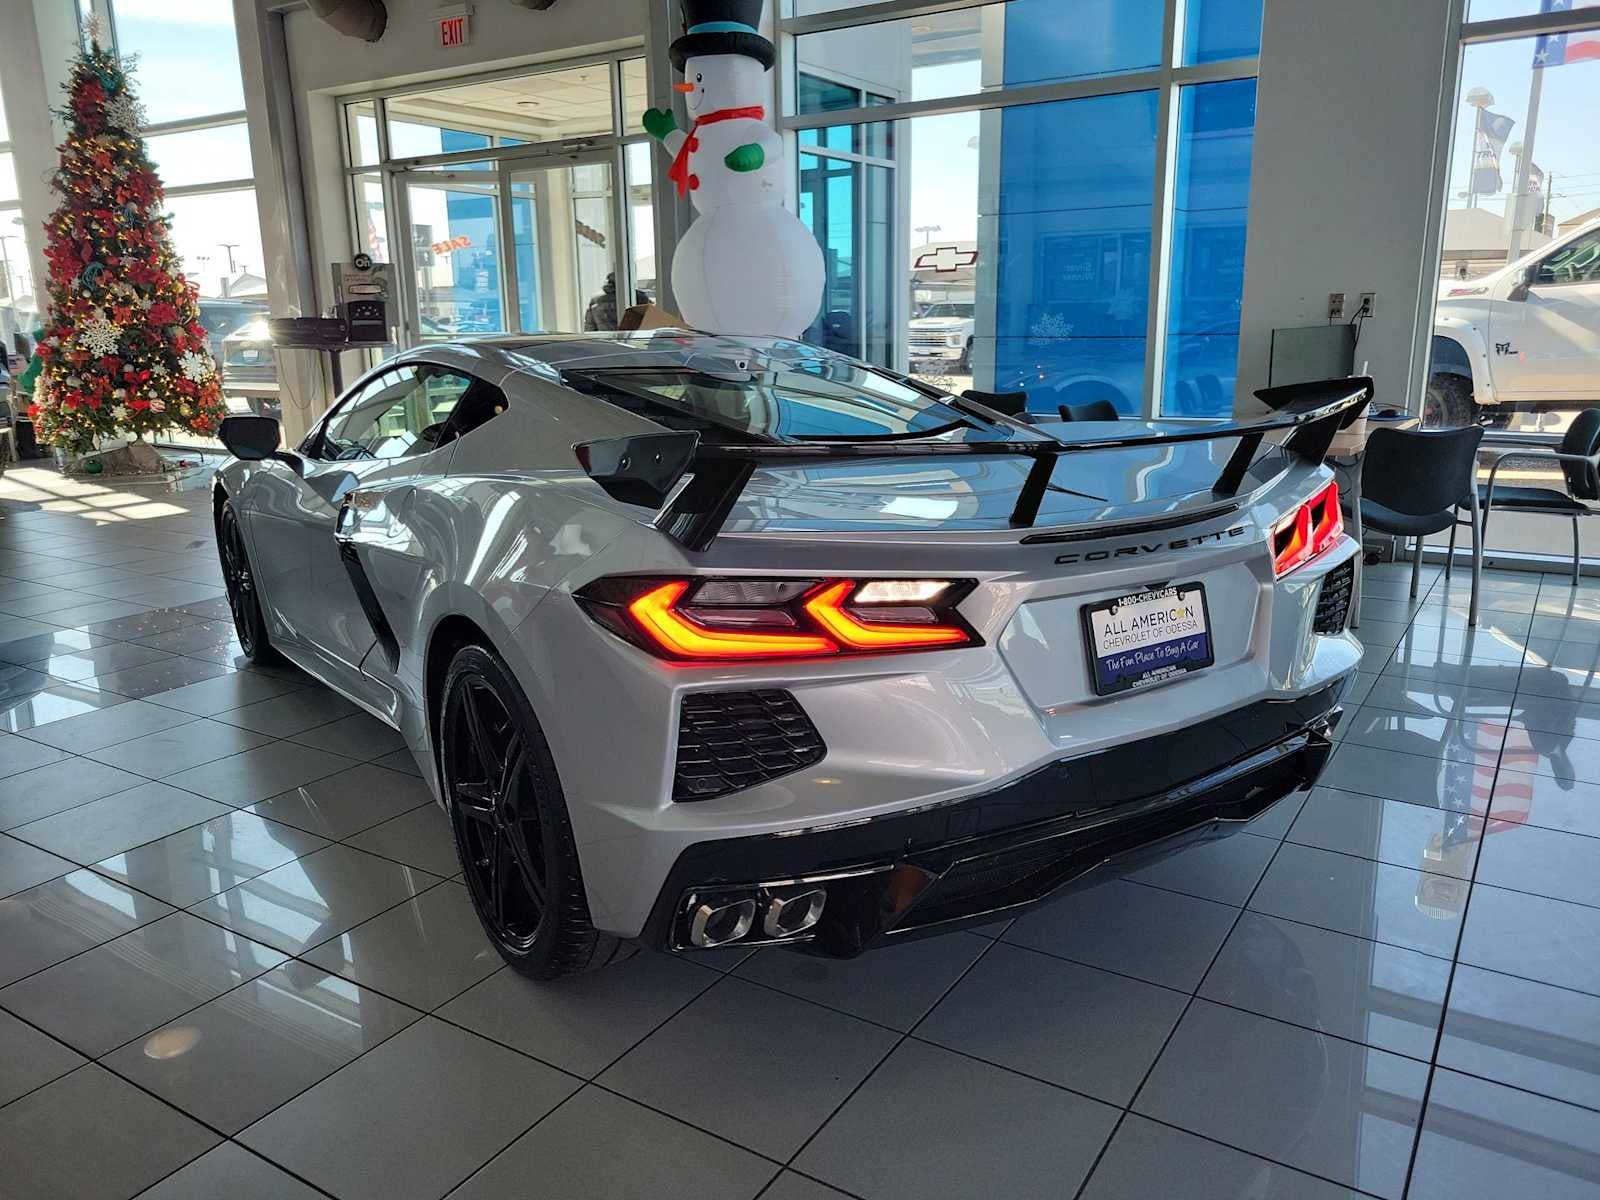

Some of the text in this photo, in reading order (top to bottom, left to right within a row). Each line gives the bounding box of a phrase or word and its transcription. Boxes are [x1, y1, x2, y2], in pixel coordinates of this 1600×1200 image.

[441, 18, 464, 46] EXIT
[1054, 526, 1245, 565] CORVETTE
[1103, 619, 1198, 650] CHEVROLET OF ODESSA
[1104, 620, 1128, 637] ALL
[1105, 640, 1199, 672] The Fun Place To Buy A Car
